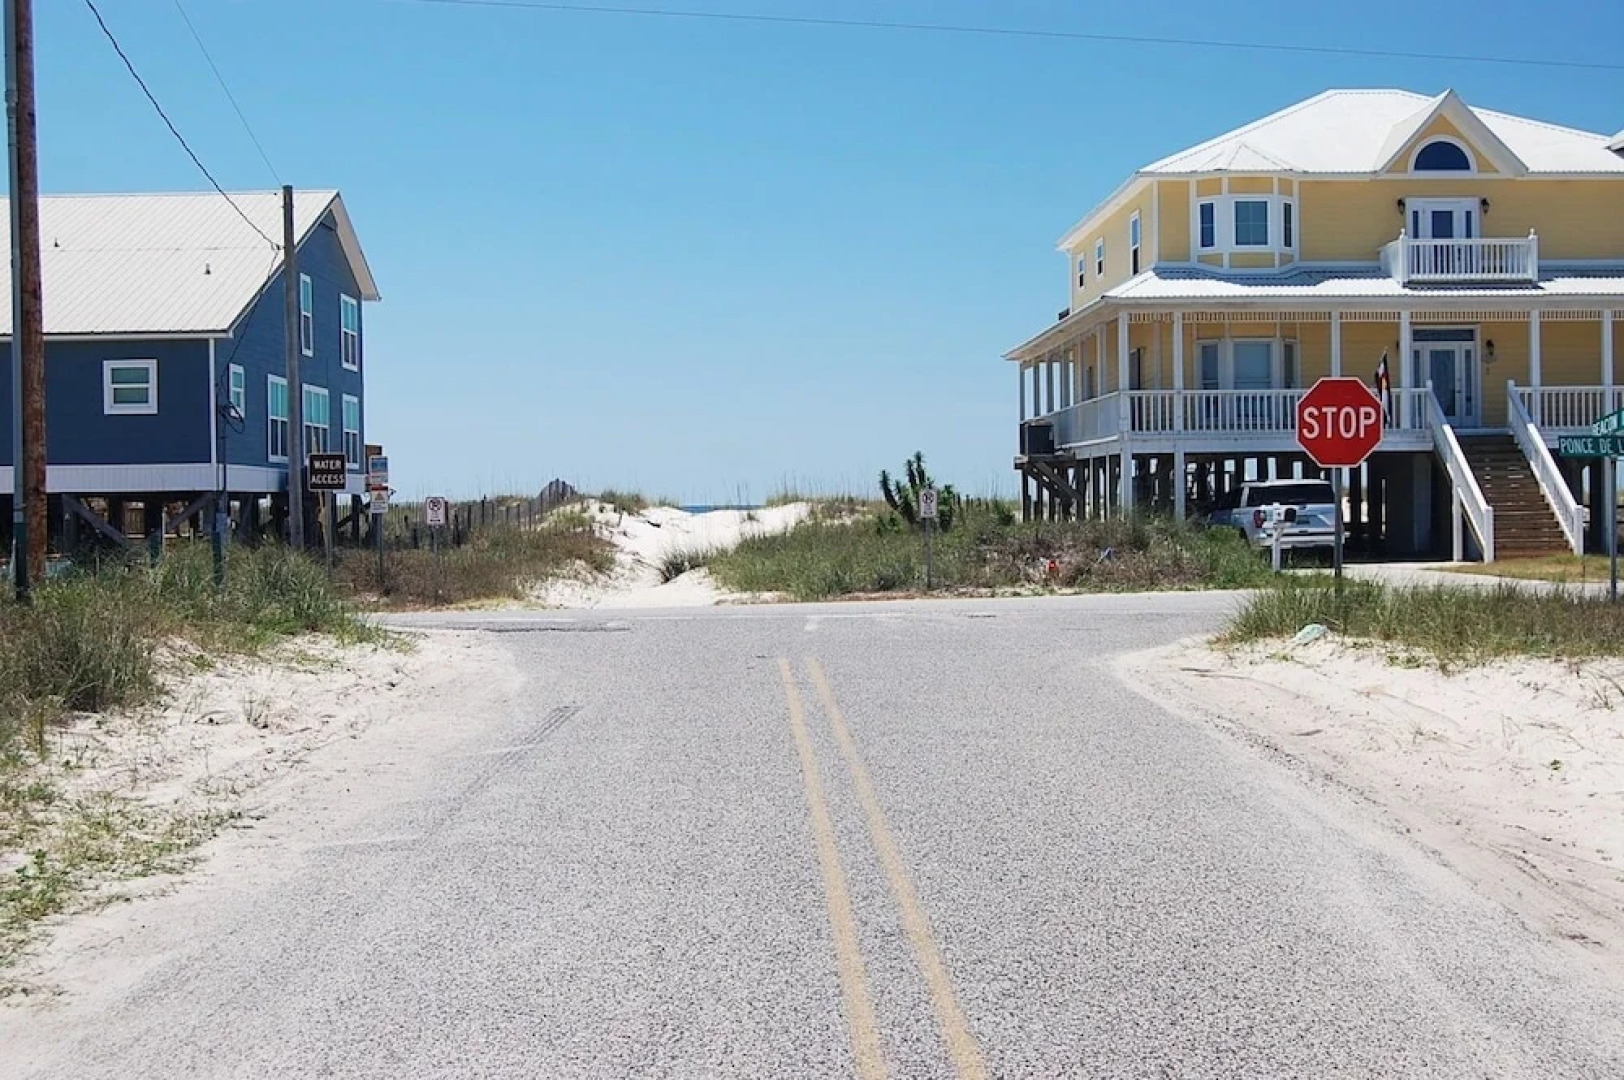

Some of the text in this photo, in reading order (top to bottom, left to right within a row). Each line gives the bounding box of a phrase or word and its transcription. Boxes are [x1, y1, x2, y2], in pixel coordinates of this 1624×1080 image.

[1302, 406, 1377, 439] STOP
[1560, 438, 1595, 454] PONCE
[1600, 438, 1613, 454] DE
[313, 460, 342, 470] WATER
[311, 473, 345, 485] ACCESS
